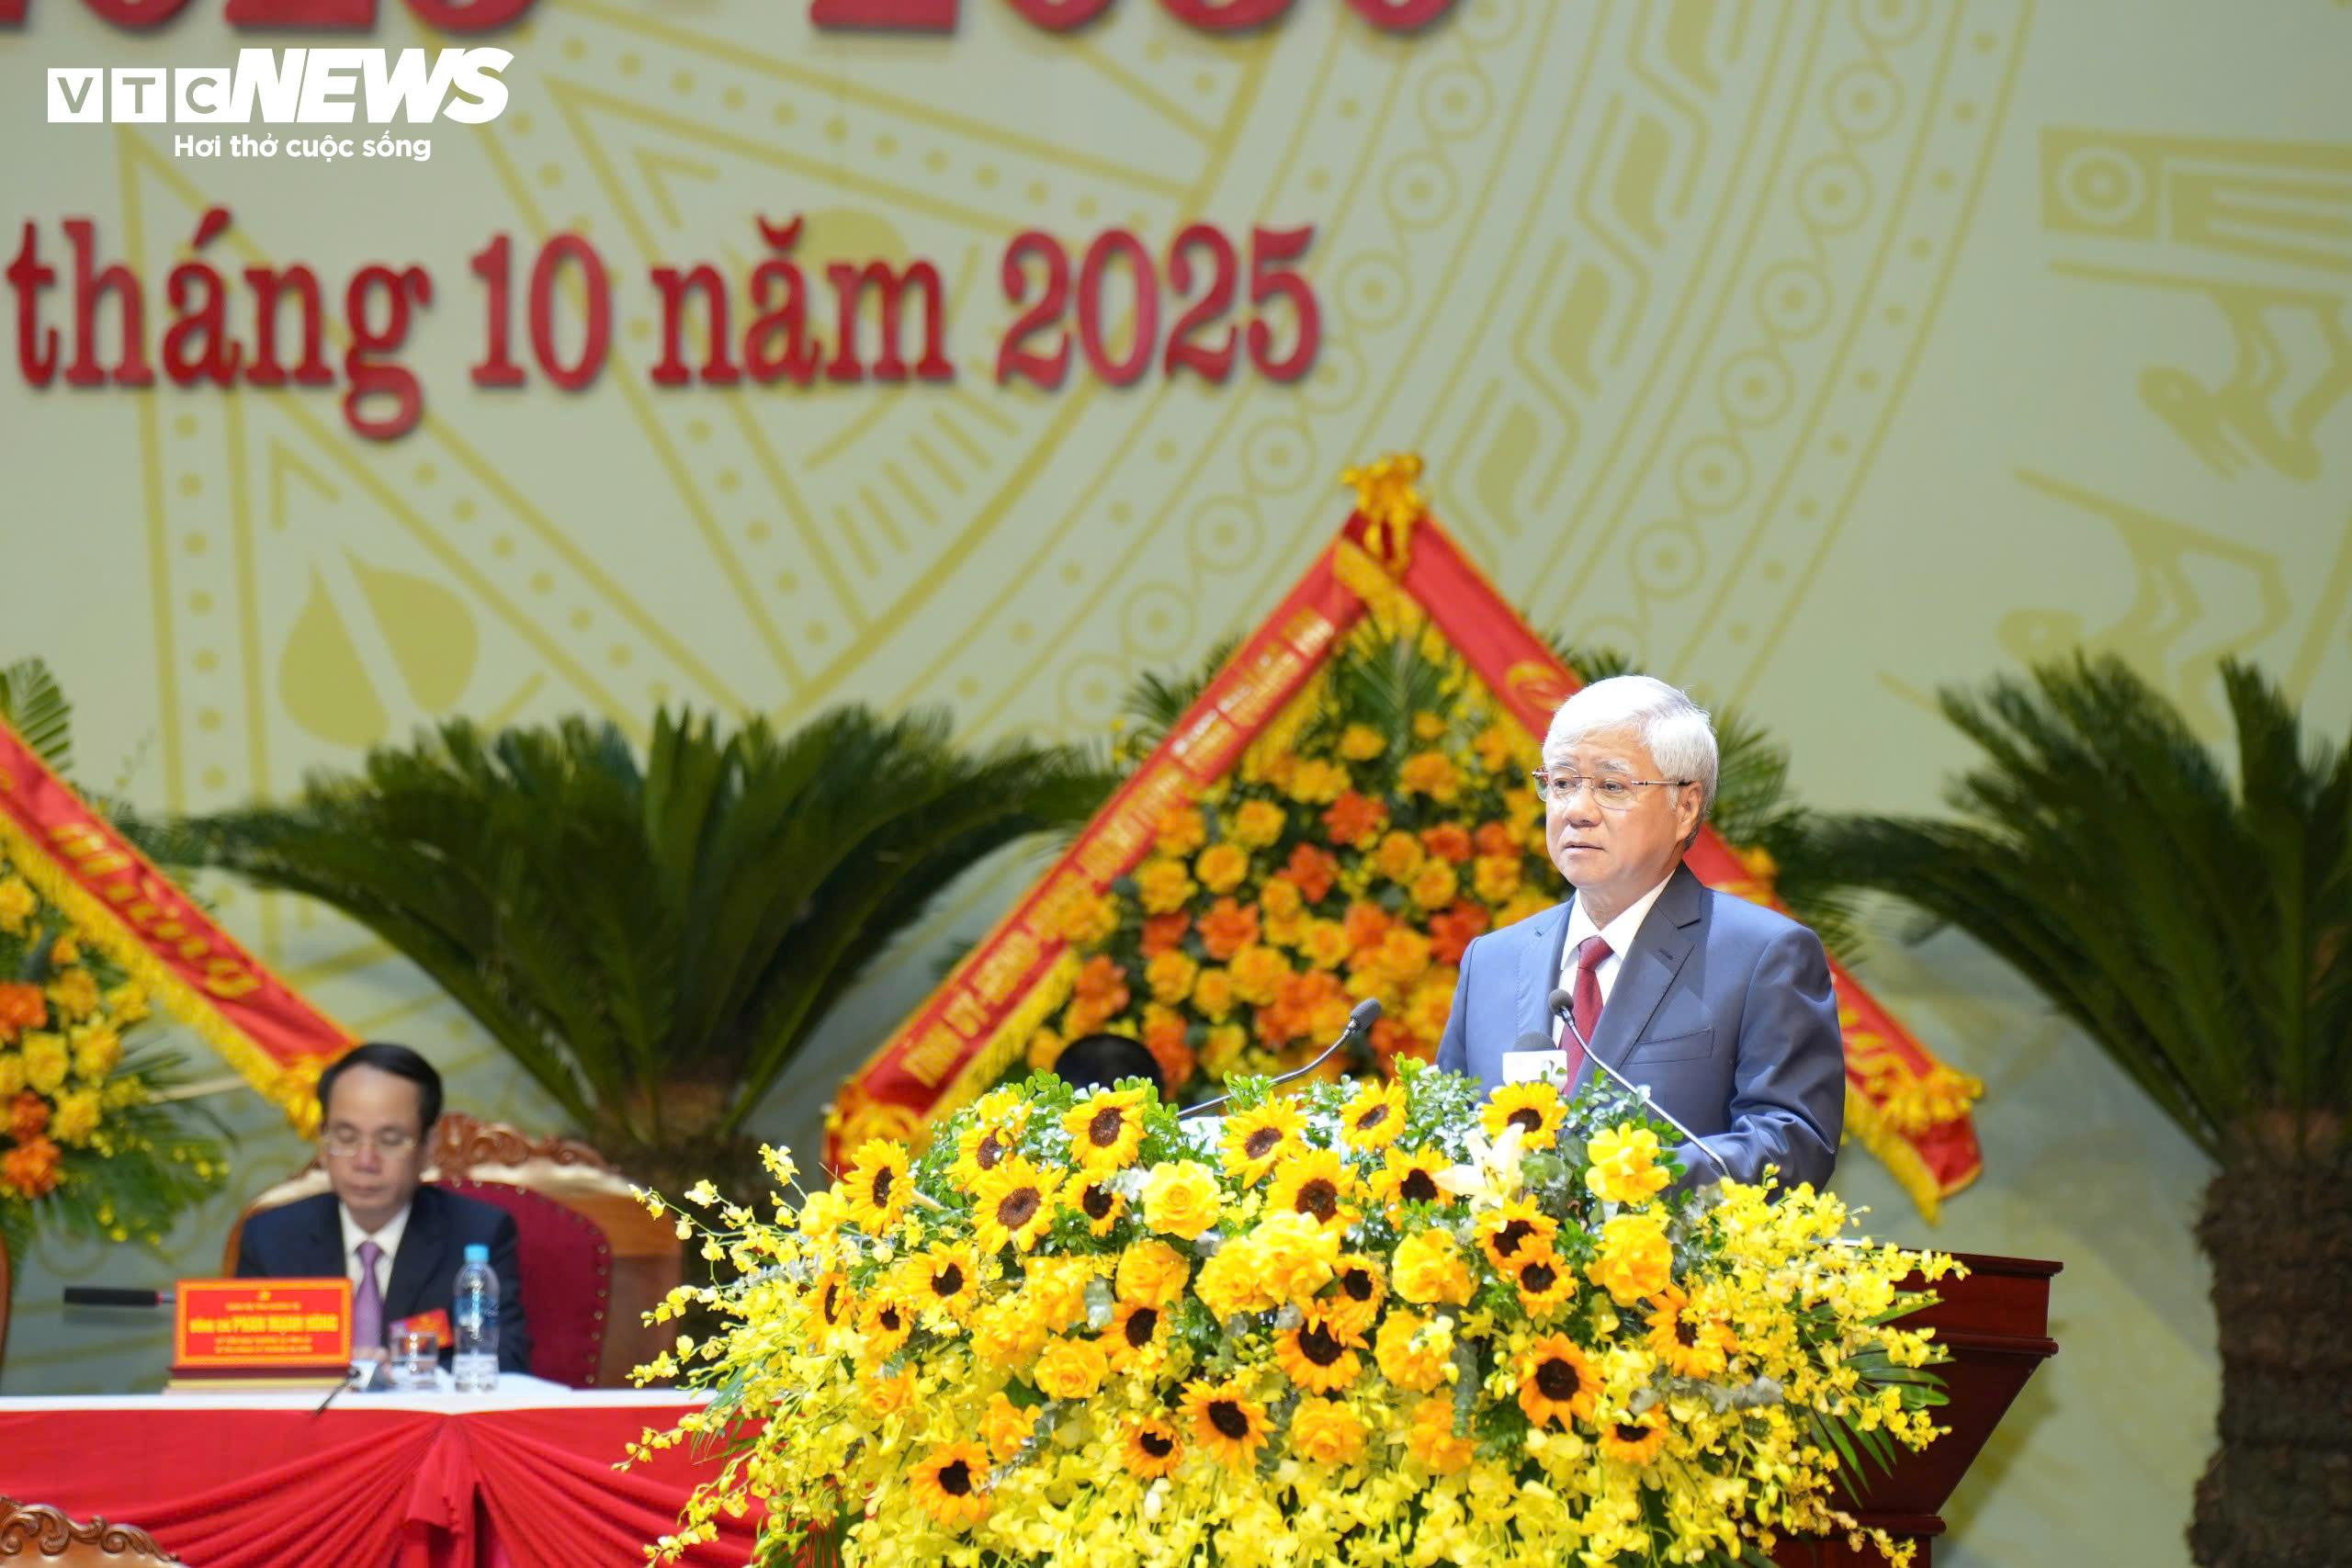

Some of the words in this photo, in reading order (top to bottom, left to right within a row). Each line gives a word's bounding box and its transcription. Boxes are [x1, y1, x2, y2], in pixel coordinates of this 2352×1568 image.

[5, 205, 433, 440] tháng
[471, 233, 611, 390] 10
[650, 214, 953, 386] năm
[996, 224, 1319, 388] 2025
